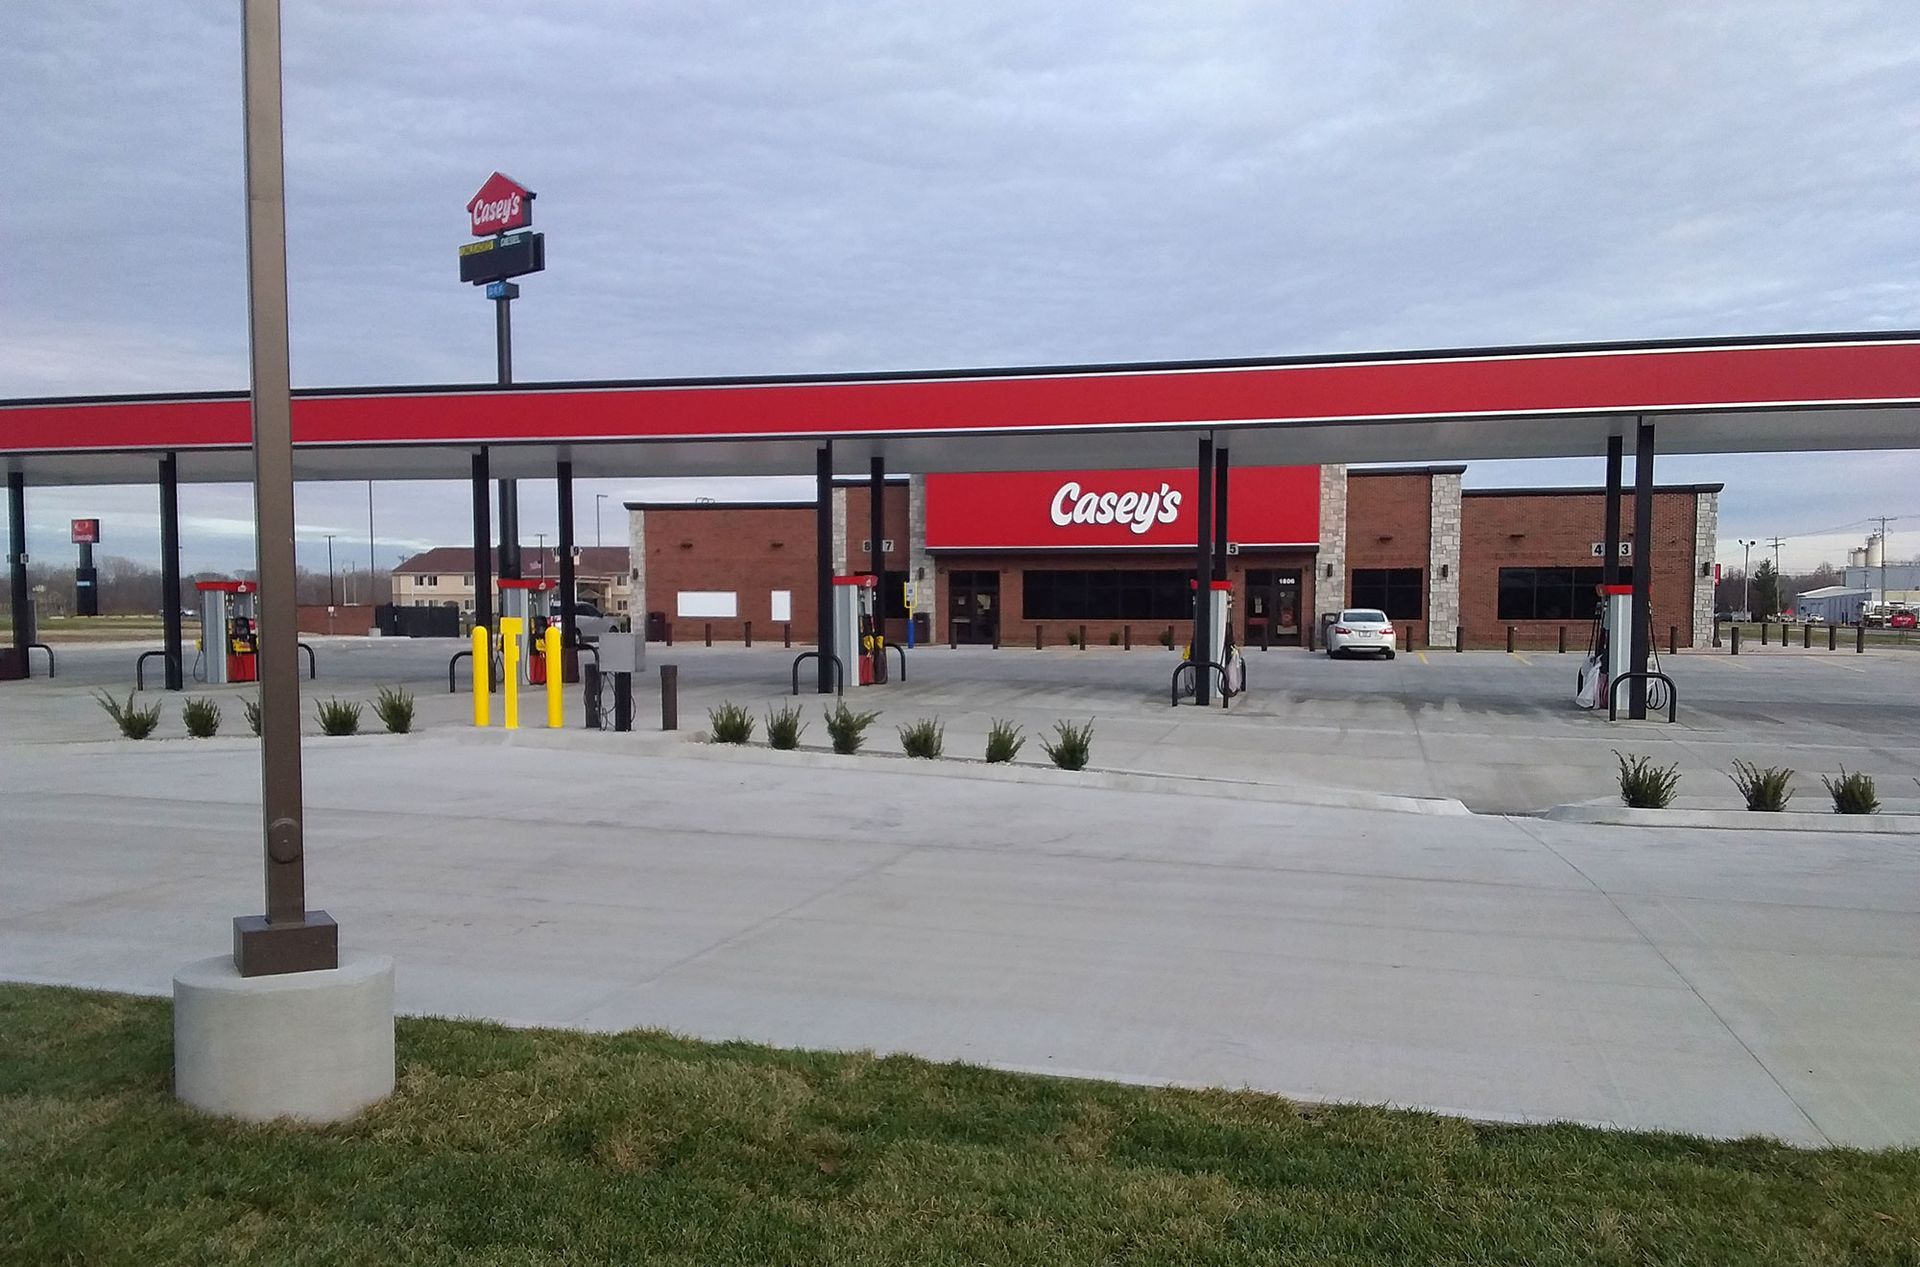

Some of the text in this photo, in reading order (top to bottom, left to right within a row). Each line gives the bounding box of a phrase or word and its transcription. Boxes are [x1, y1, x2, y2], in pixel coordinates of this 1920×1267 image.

[473, 192, 520, 225] Casey's
[1051, 482, 1182, 534] Casey's
[864, 542, 871, 551] 8
[885, 542, 892, 551] 7
[1229, 544, 1237, 554] 5
[1594, 544, 1602, 555] 4
[1621, 544, 1629, 555] 3
